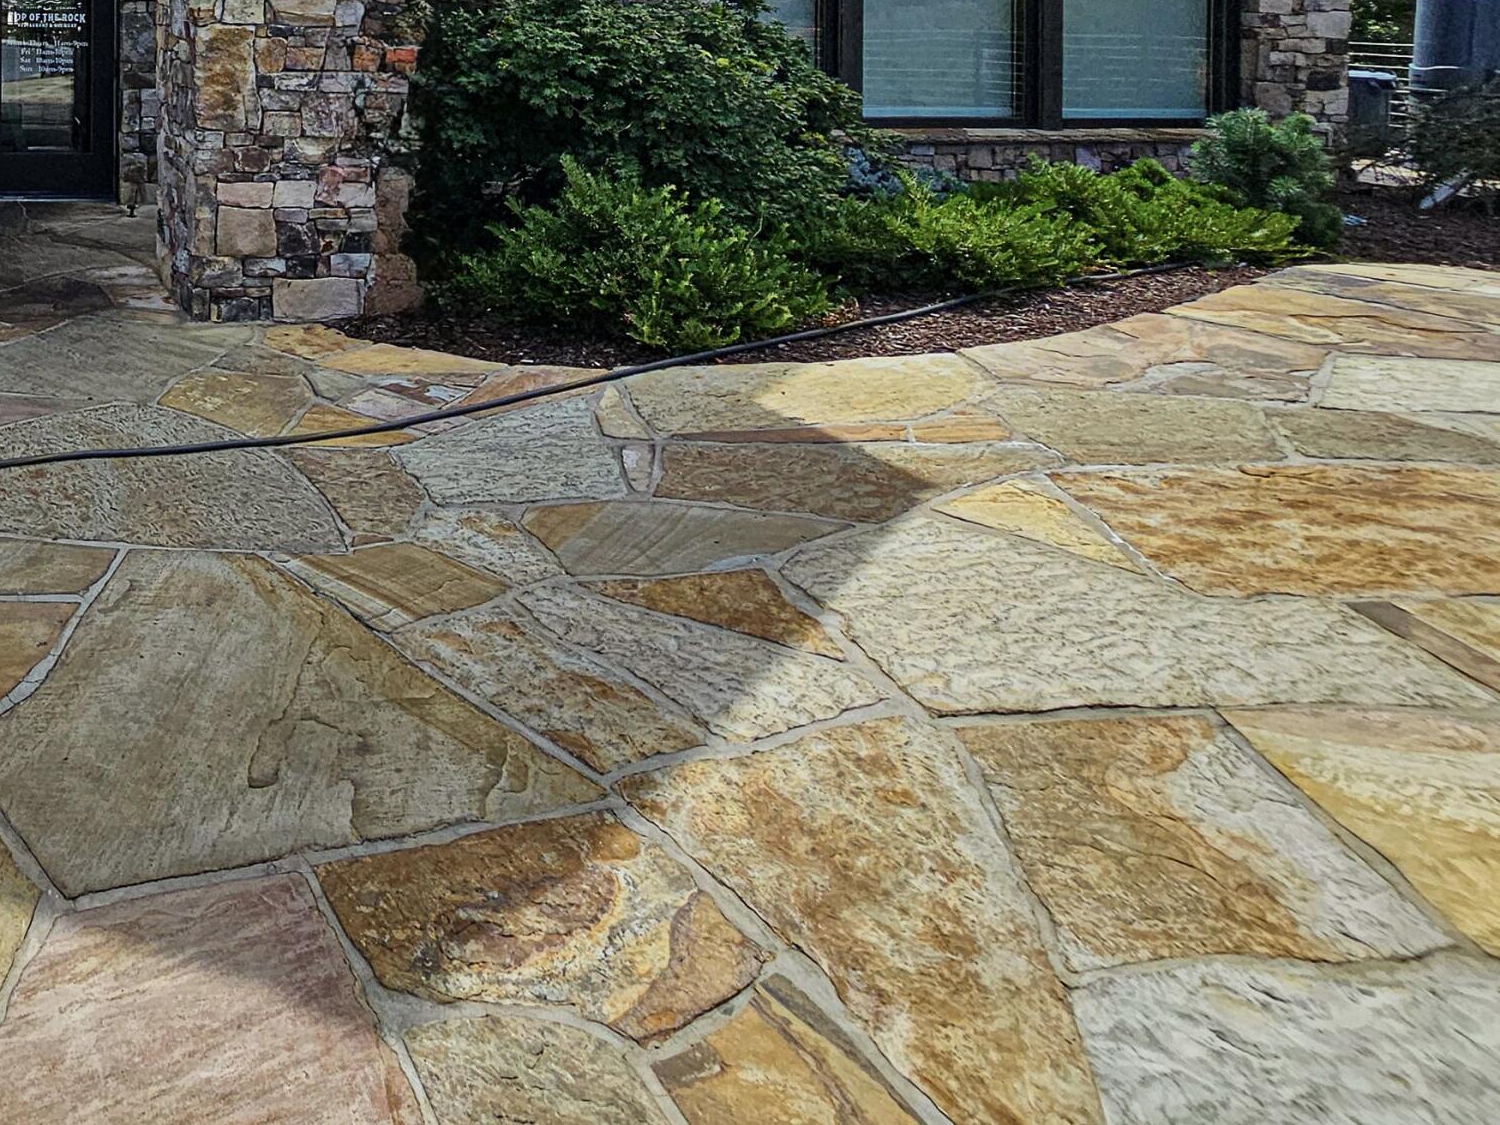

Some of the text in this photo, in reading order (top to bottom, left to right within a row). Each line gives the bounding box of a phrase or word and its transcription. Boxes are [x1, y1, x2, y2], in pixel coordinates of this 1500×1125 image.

[29, 13, 40, 22] OF
[41, 13, 60, 23] THE
[61, 13, 86, 24] ROCK
